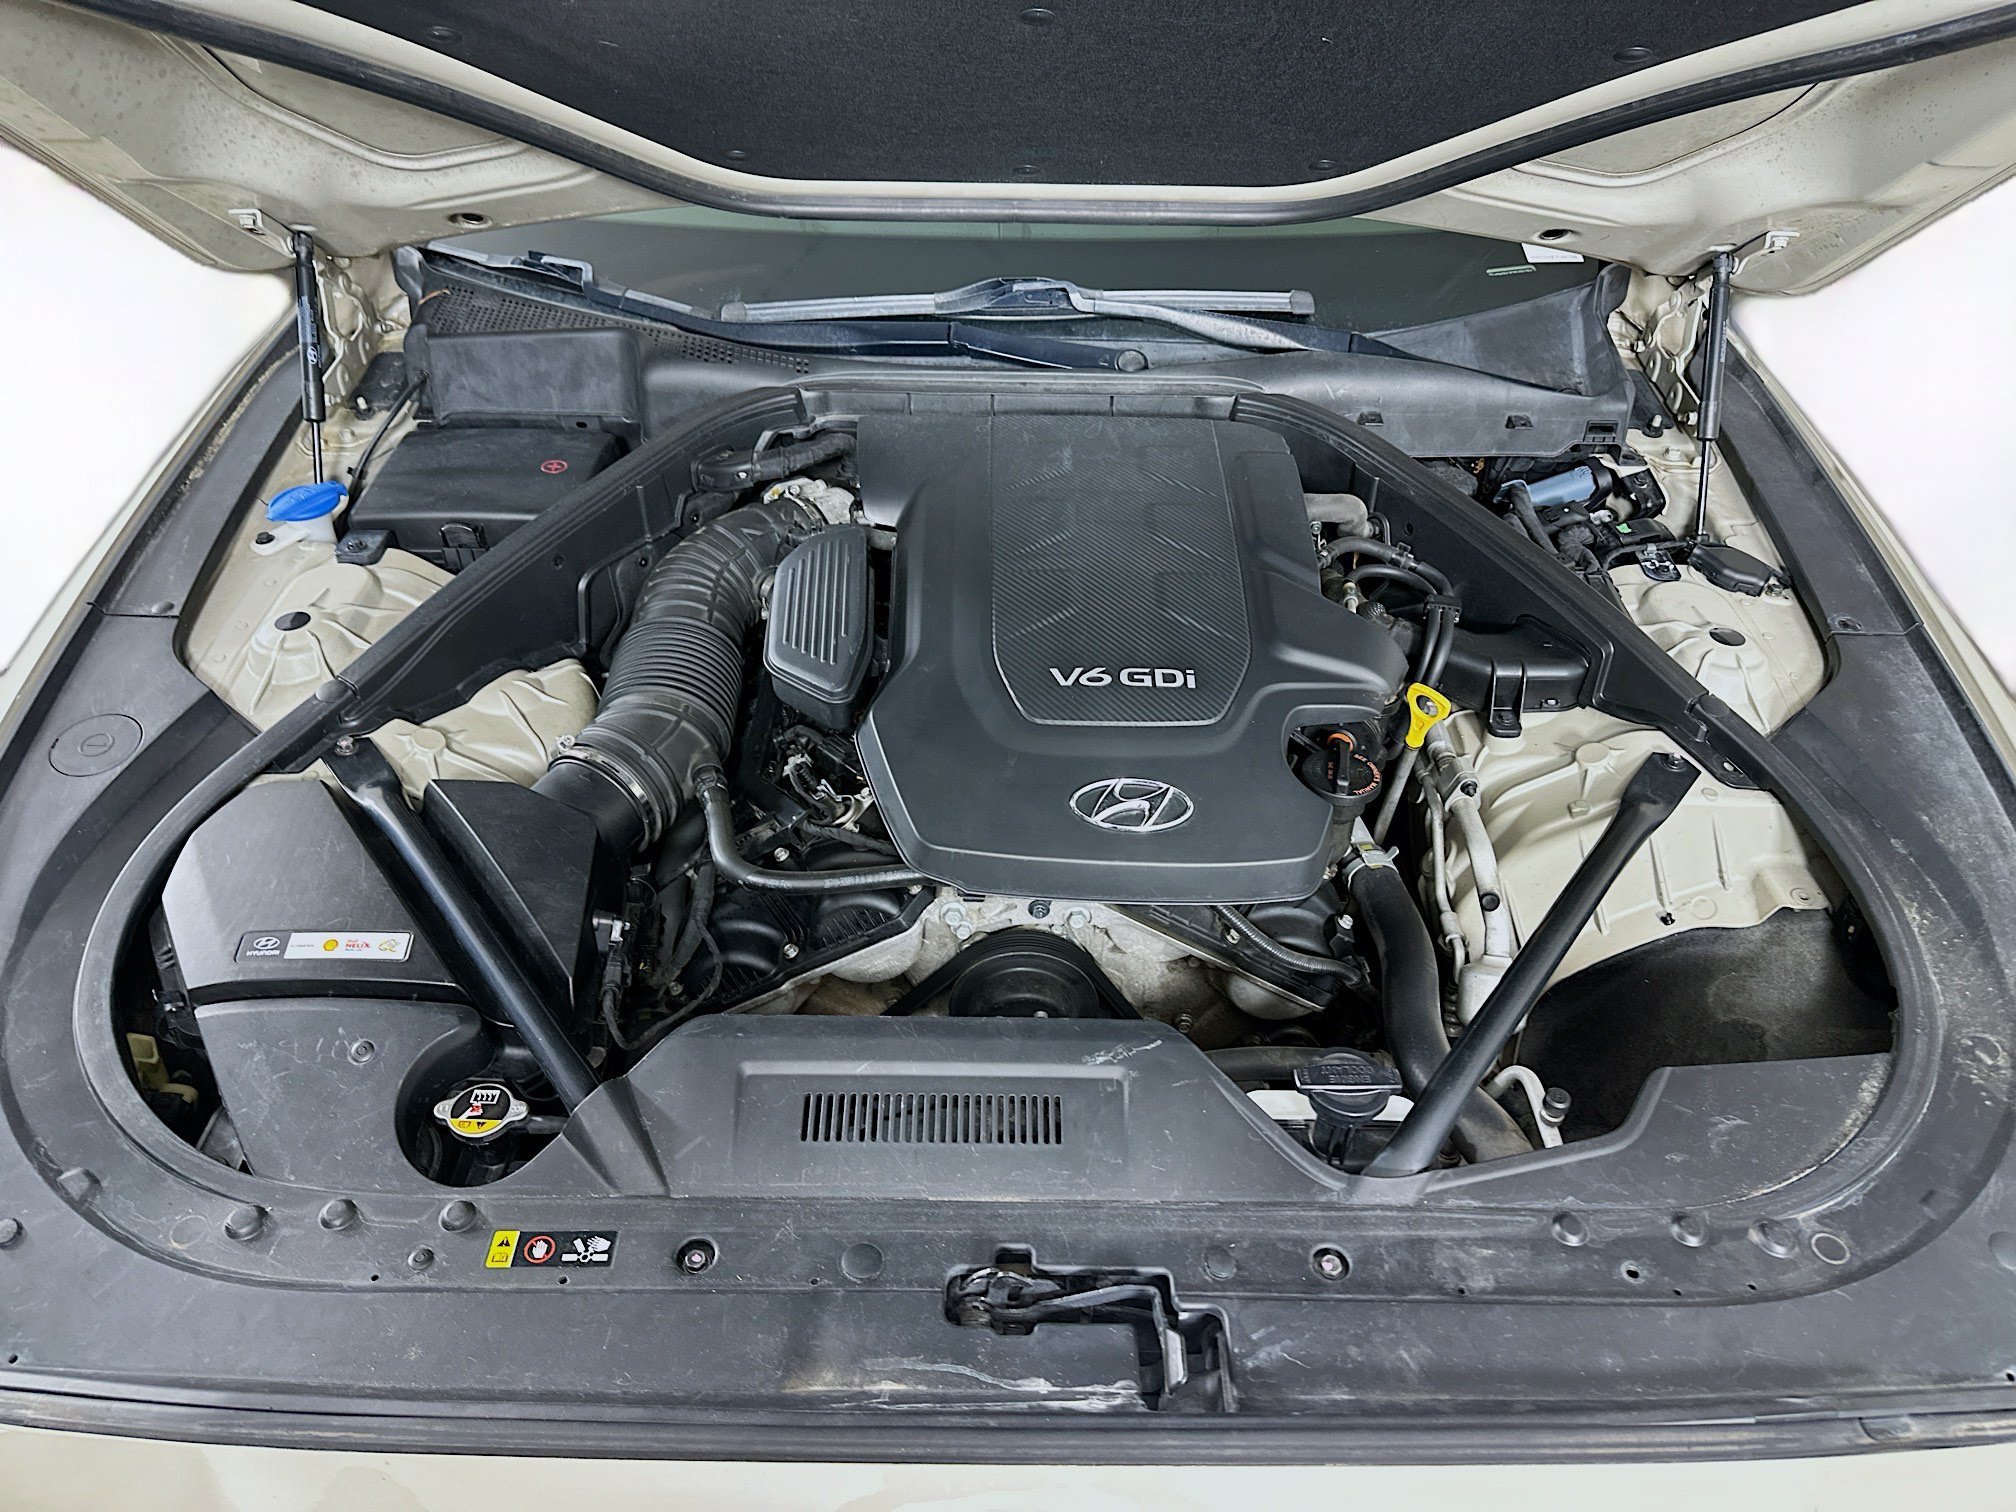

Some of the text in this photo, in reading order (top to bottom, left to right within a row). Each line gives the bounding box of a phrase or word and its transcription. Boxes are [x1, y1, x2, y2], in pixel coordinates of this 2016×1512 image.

[1049, 667, 1197, 689] V6 GDi
[246, 949, 280, 957] HYUNDAI
[1321, 1066, 1374, 1074] COOLANT
[1329, 1075, 1371, 1084] ENGINE
